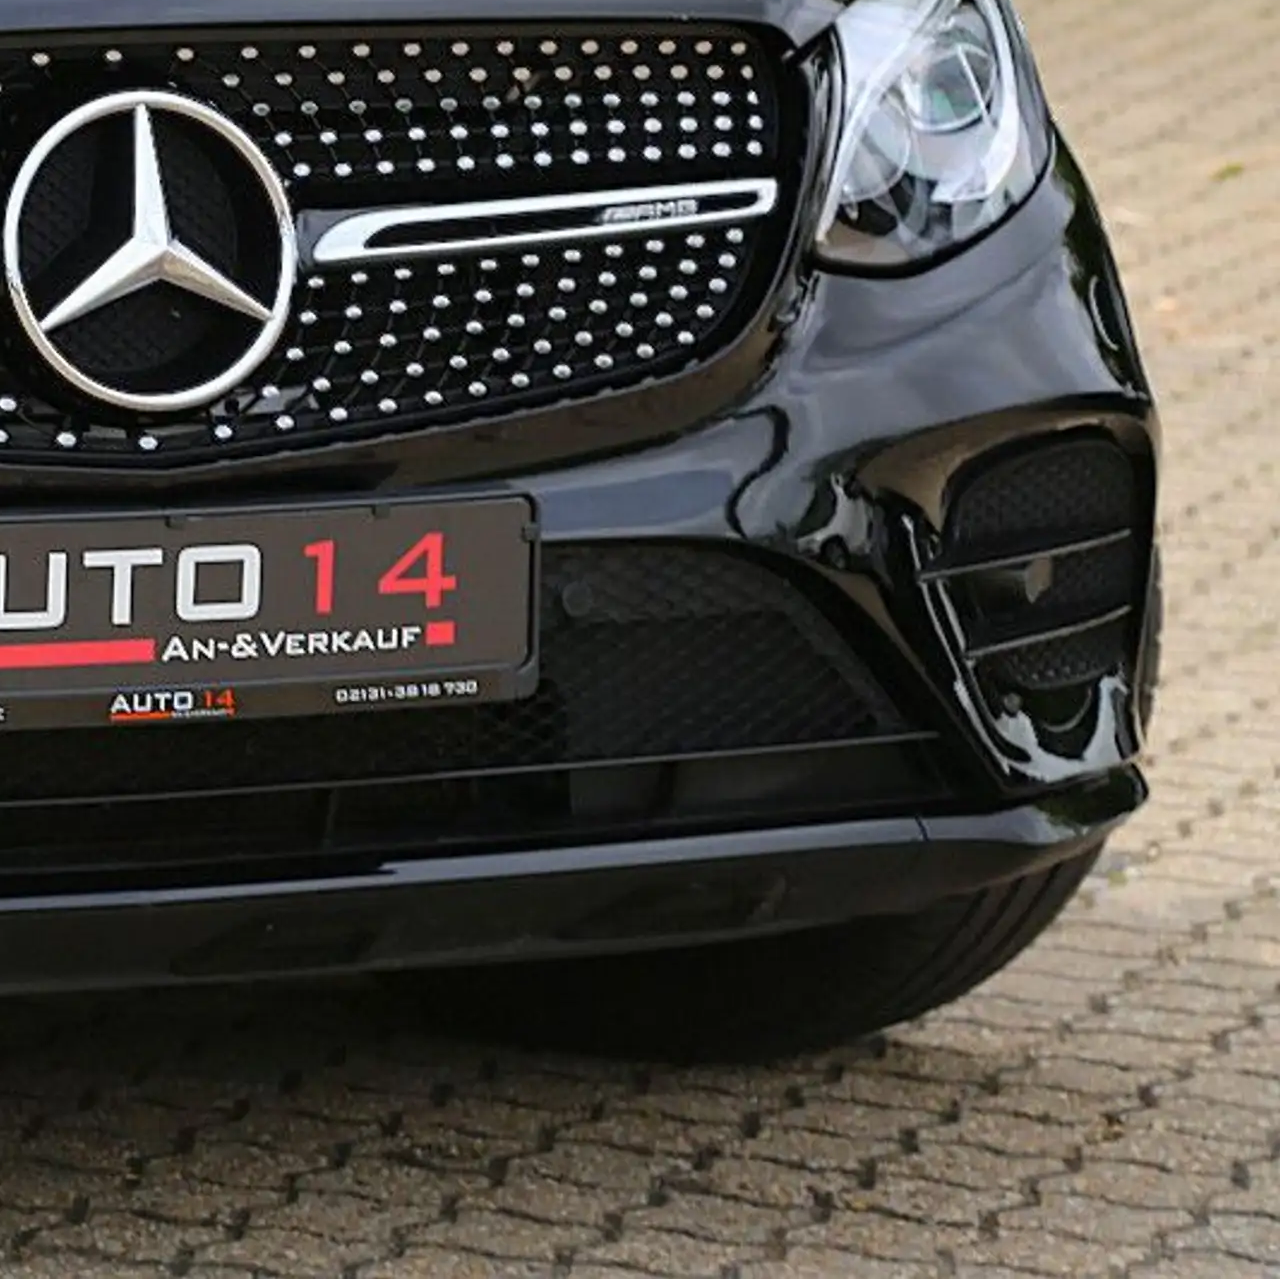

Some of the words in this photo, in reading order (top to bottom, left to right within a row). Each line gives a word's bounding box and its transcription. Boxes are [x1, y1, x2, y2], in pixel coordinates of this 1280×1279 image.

[304, 531, 457, 615] 14
[110, 691, 194, 714] AUTO
[204, 687, 236, 709] 14
